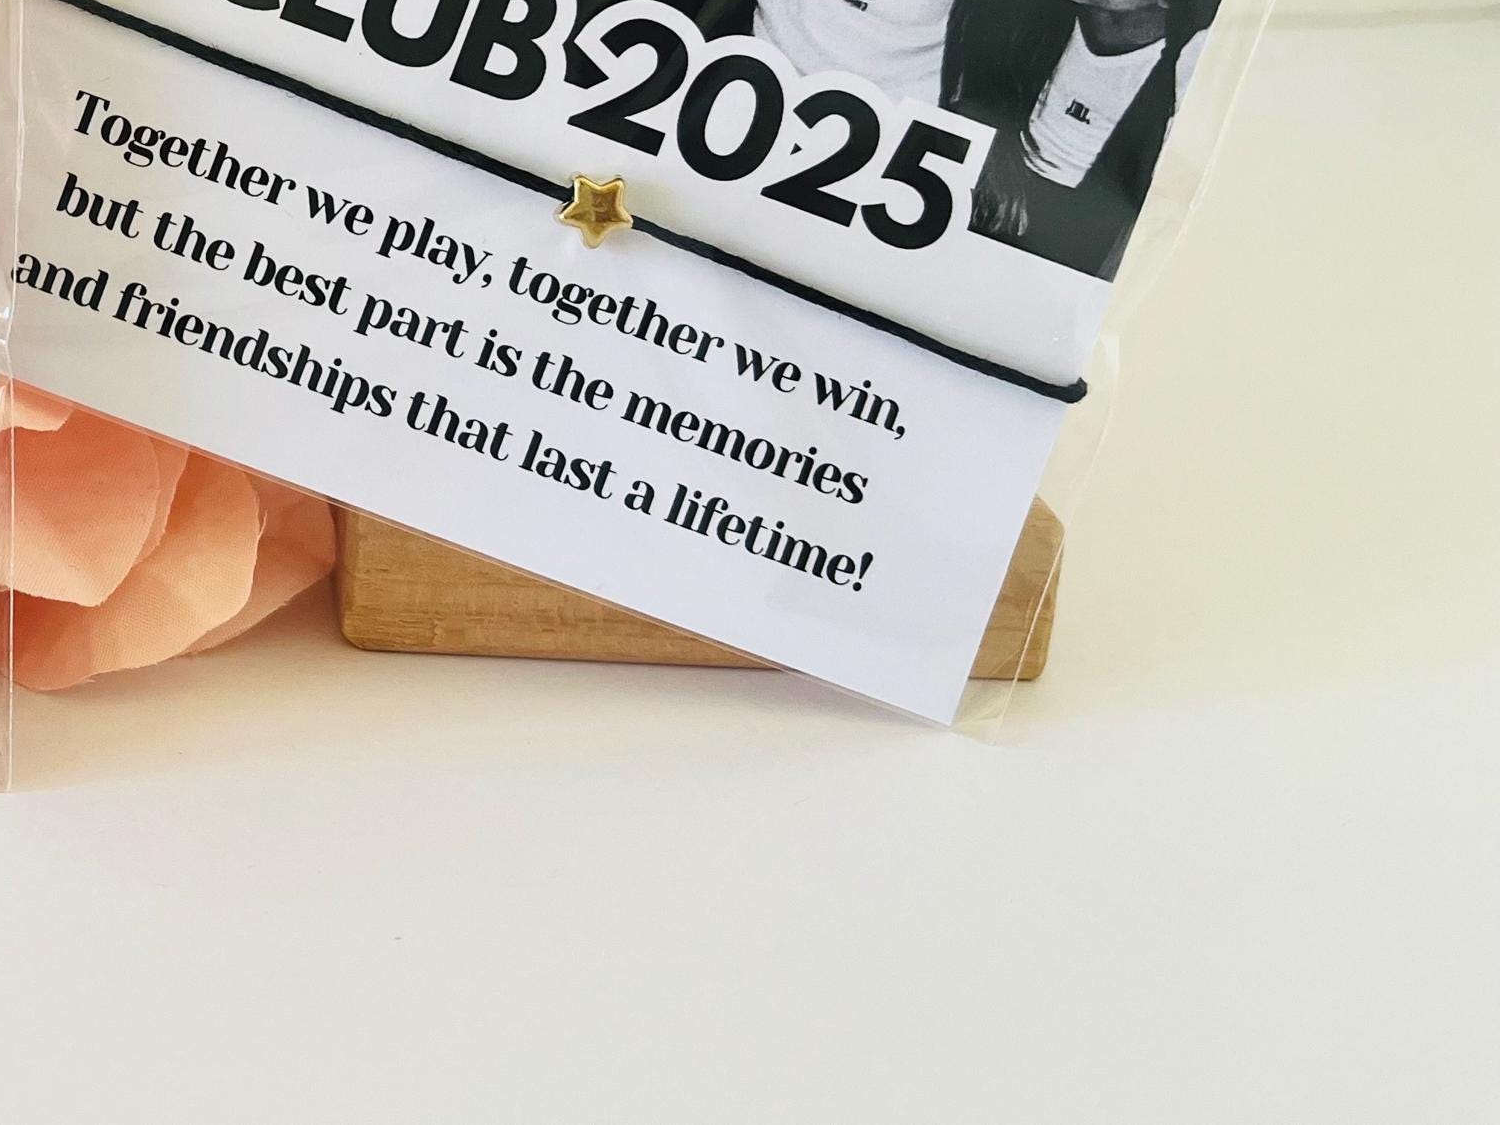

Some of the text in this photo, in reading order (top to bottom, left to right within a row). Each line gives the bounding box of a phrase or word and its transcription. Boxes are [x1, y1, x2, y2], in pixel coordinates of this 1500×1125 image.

[74, 90, 905, 439] Together we play, together we win,
[566, 18, 972, 250] 2025
[12, 254, 873, 591] and friendships that last a lifetime!
[56, 172, 868, 503] but the best part is the memories
